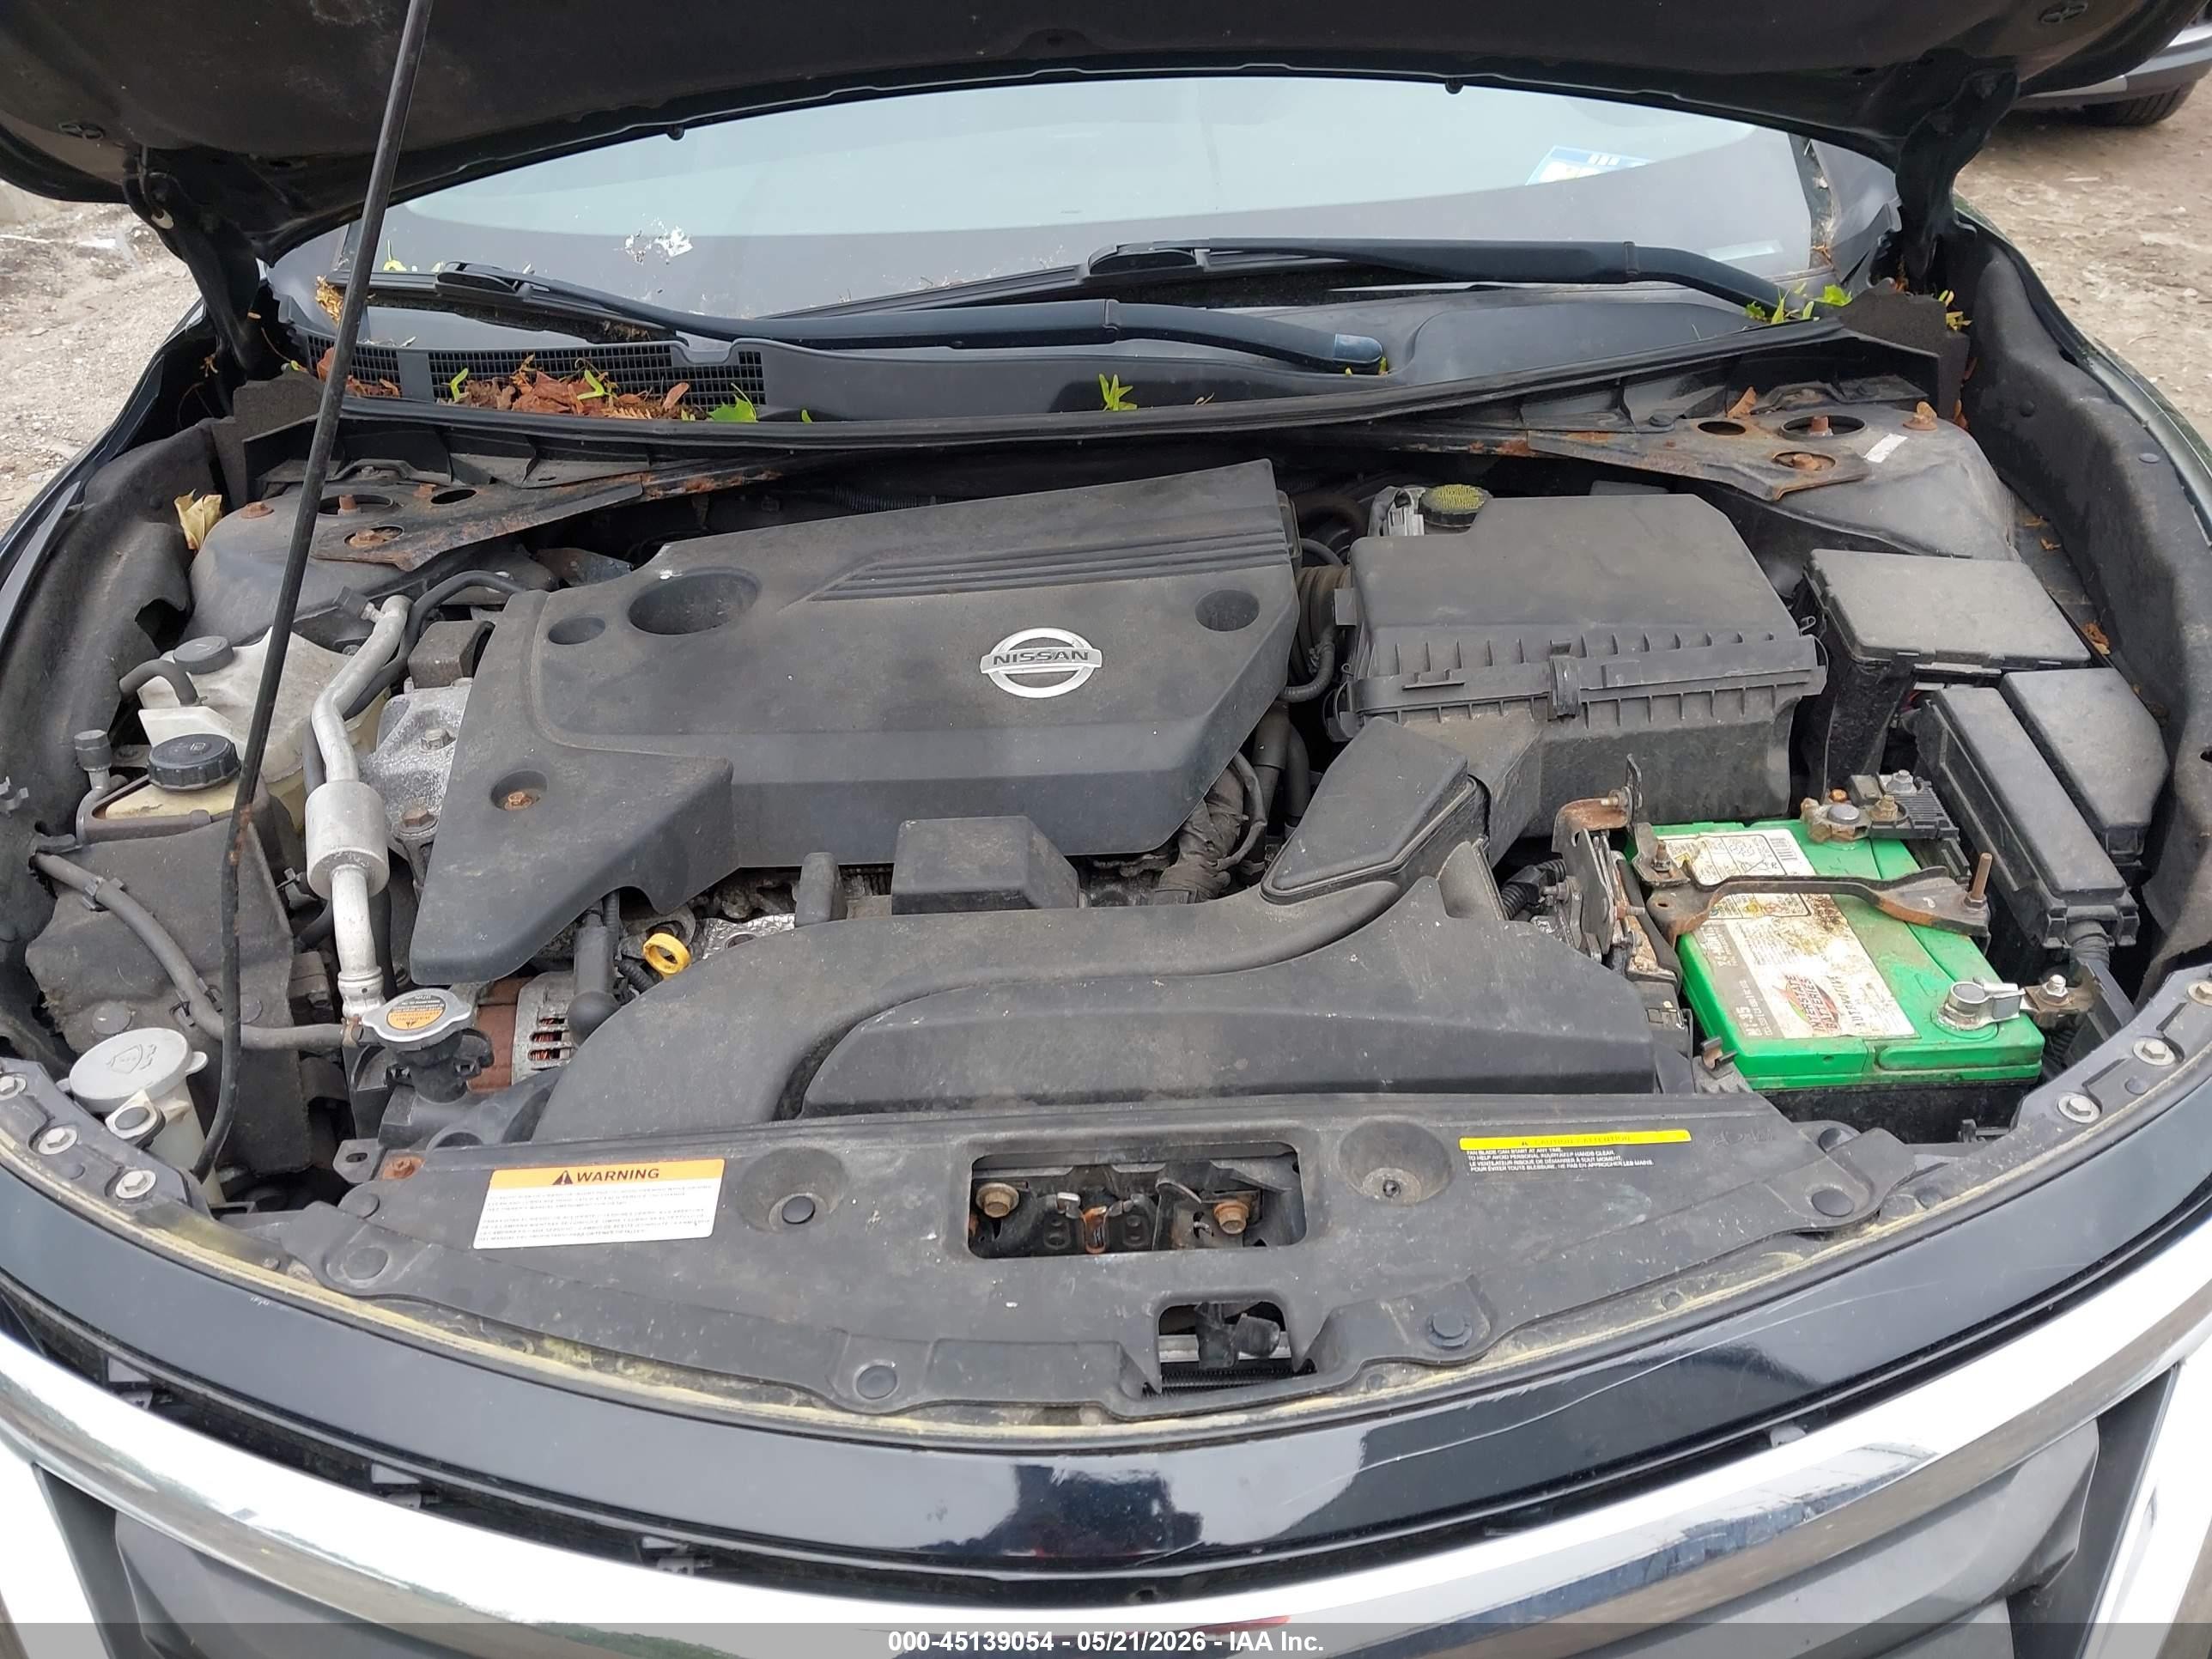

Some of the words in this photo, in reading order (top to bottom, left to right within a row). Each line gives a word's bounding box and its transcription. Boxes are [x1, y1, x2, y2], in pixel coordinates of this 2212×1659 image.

[993, 650, 1089, 665] NISSAN
[1784, 975, 1826, 1031] INTERSTATE
[1800, 978, 1838, 1030] BATTERIES
[576, 1168, 659, 1182] WARNING
